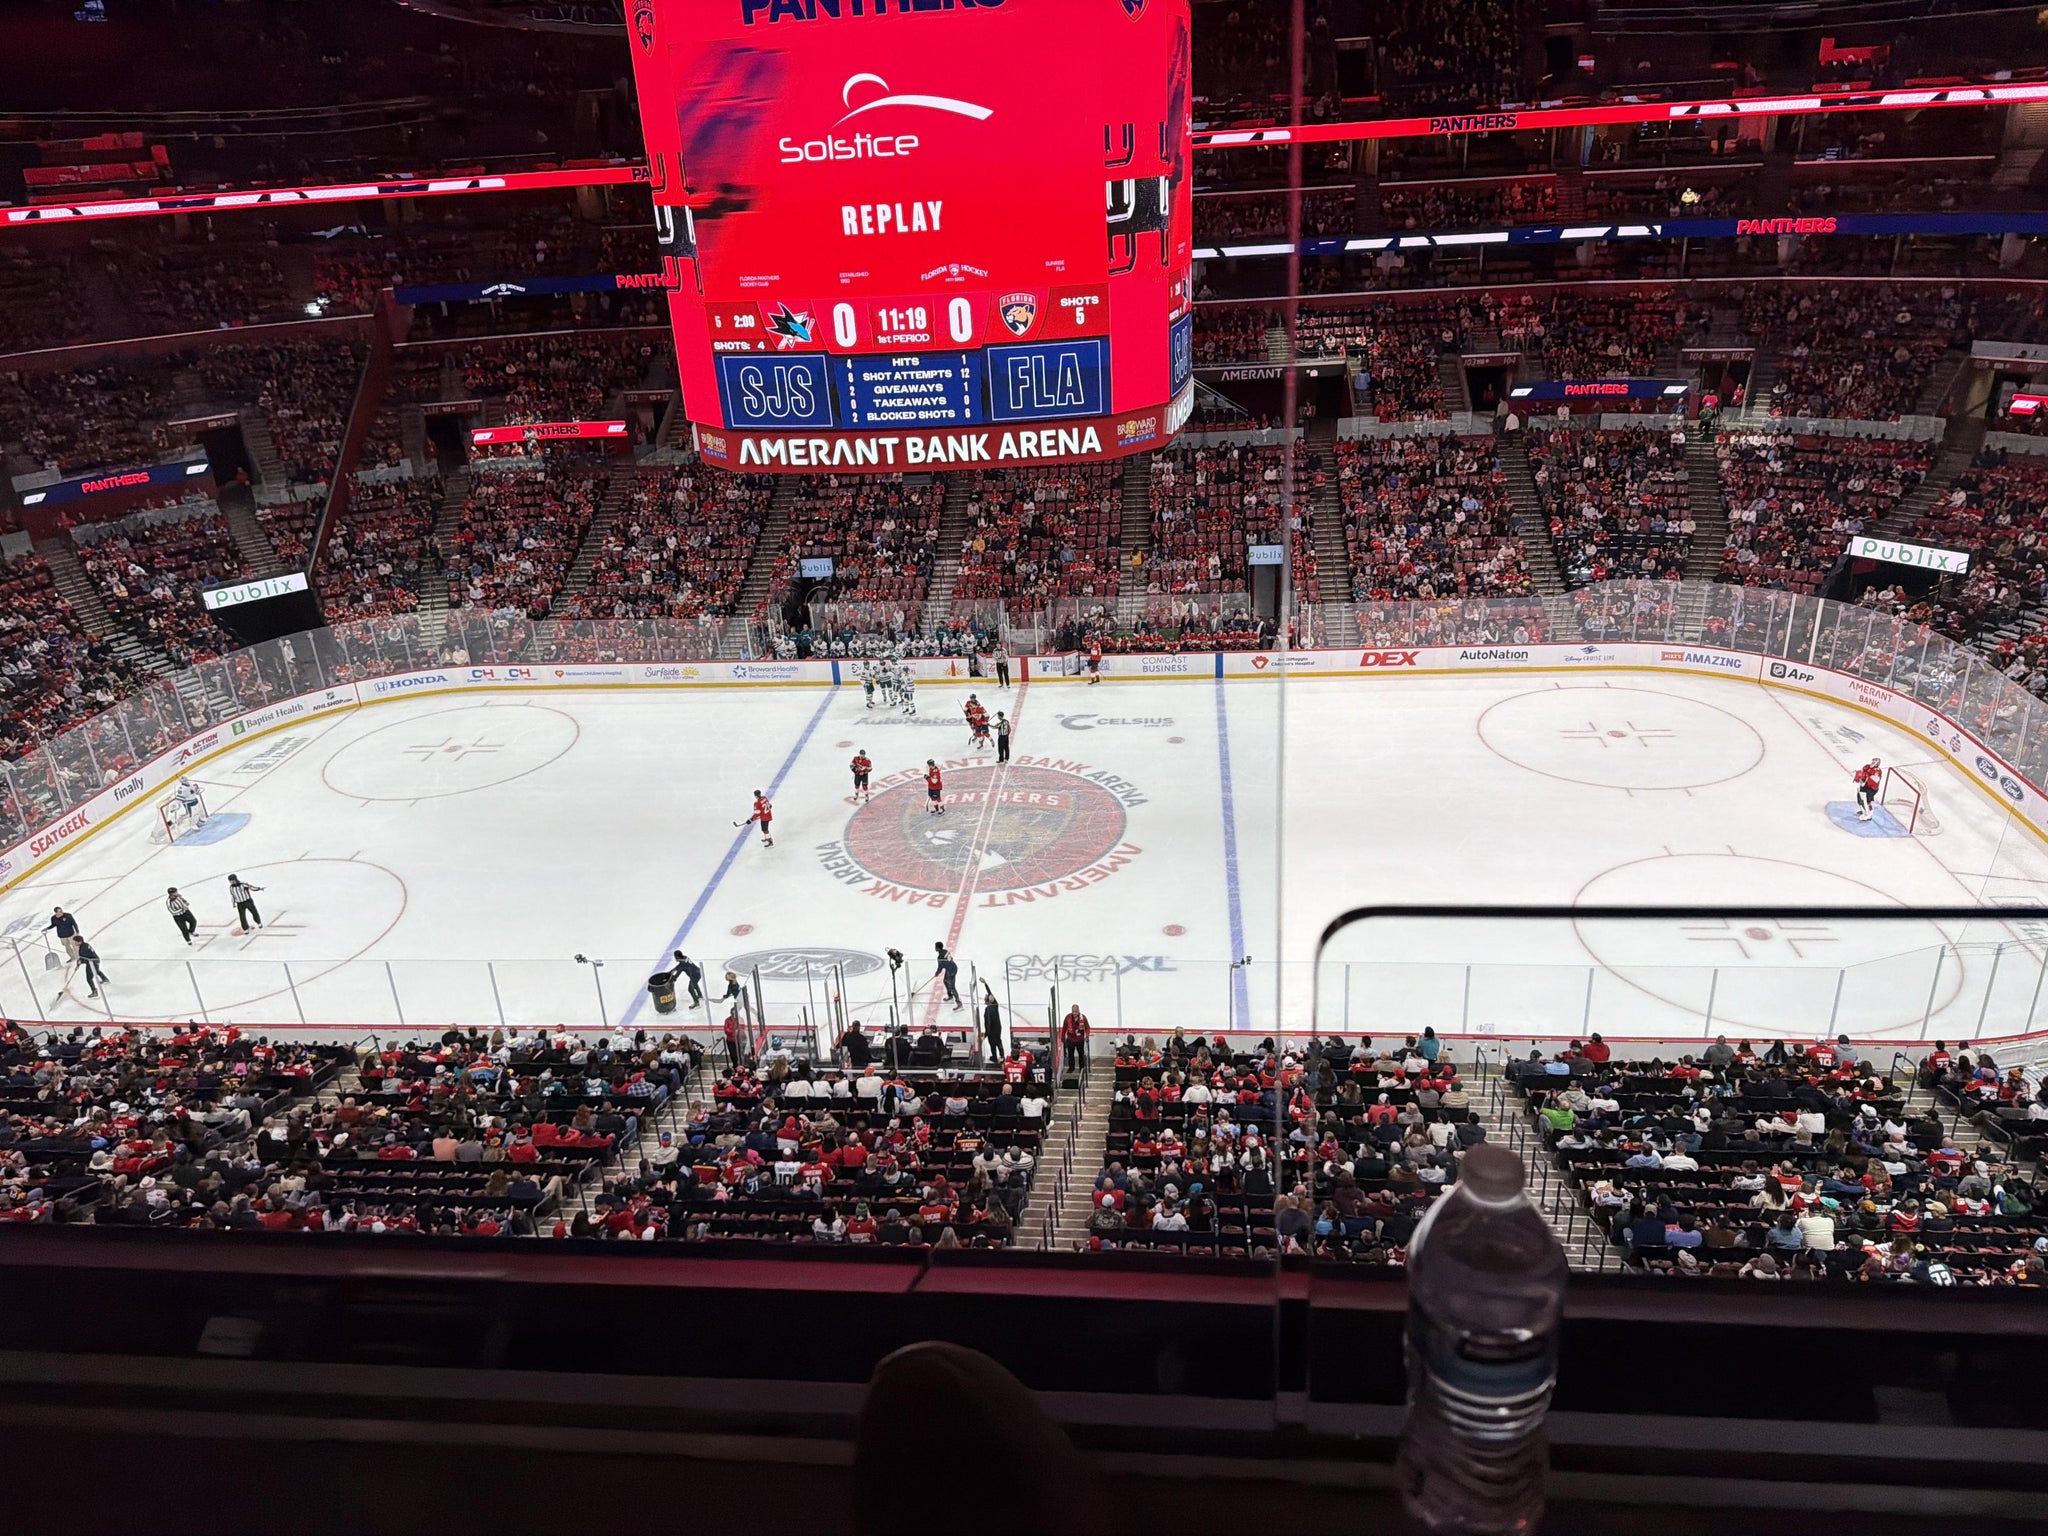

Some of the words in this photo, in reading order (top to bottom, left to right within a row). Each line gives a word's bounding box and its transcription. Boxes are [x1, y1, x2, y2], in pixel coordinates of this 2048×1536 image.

[1430, 114, 1517, 133] PANTHERS
[779, 133, 919, 164] Solstice
[841, 200, 943, 236] REPLAY
[1736, 217, 1837, 235] PANTHERS
[616, 273, 664, 288] PANTH
[921, 265, 947, 281] FLORIDA
[961, 264, 988, 278] HOCKEY
[1060, 296, 1099, 307] SHOTS
[714, 315, 722, 328] 5
[733, 315, 755, 328] 2:00
[878, 307, 927, 331] 11:19
[948, 297, 972, 343] 0
[1075, 307, 1085, 325] 5
[832, 302, 857, 348] 0
[713, 341, 750, 350] SHOTS:
[757, 341, 765, 350] 4
[877, 335, 892, 344] 1st
[892, 333, 930, 343] PERIOD
[847, 359, 852, 369] 4
[892, 357, 919, 367] HITS
[961, 354, 967, 365] 1
[848, 372, 854, 383] 8
[863, 372, 892, 381] SHOT
[894, 369, 952, 380] ATTEMPTS
[960, 368, 970, 378] 12
[1007, 352, 1085, 409] FLA
[1221, 368, 1283, 381] AMERANT
[741, 364, 816, 418] SJS
[849, 386, 856, 396] 2
[874, 384, 944, 394] GIVEAWAYS
[963, 382, 968, 392] 1
[1565, 384, 1628, 395] PANTHERS
[851, 399, 857, 409] 0
[873, 397, 947, 407] TAKEAWAYS
[964, 395, 970, 405] 0
[852, 412, 858, 423] 2
[867, 411, 917, 421] BLOCKED
[918, 410, 955, 419] SHOTS
[965, 408, 970, 418] 6
[522, 425, 580, 437] PNTHERS
[1136, 427, 1156, 437] COUNTY
[739, 437, 899, 465] AMERANT
[905, 434, 991, 464] BANK
[998, 426, 1102, 460] ARENA
[81, 472, 150, 493] PANTHERS
[1248, 551, 1282, 559] Publix
[1862, 540, 1950, 570] Publix
[801, 564, 831, 572] Publix
[215, 579, 293, 606] Publix
[1142, 656, 1187, 664] COMCAST
[1360, 651, 1421, 667] DEX
[1459, 649, 1528, 660] AutoNation
[1684, 653, 1742, 669] AMAZING
[472, 669, 495, 679] CH
[508, 668, 531, 678] CH
[644, 666, 680, 678] Surfside
[748, 665, 776, 673] Broward
[1142, 664, 1188, 673] BUSINESS
[389, 675, 448, 689] HONDA
[1849, 681, 1893, 701] AMERANT
[1858, 695, 1880, 709] BANK
[246, 711, 275, 730] Baptist
[276, 703, 304, 718] Health
[1097, 717, 1175, 725] CELSIUS
[192, 732, 218, 749] ACTION
[1979, 759, 1995, 779] Ford
[114, 776, 145, 801] finally
[1015, 755, 1094, 773] BANK
[1086, 770, 1148, 808] ARENA
[2003, 779, 2020, 800] Ford
[941, 790, 1061, 806] ANTHERS
[29, 809, 91, 859] SEATGEEK
[815, 840, 873, 886] ARENA
[860, 879, 952, 909] BANK
[757, 952, 848, 975] Ford
[1002, 966, 1111, 982] SPORT
